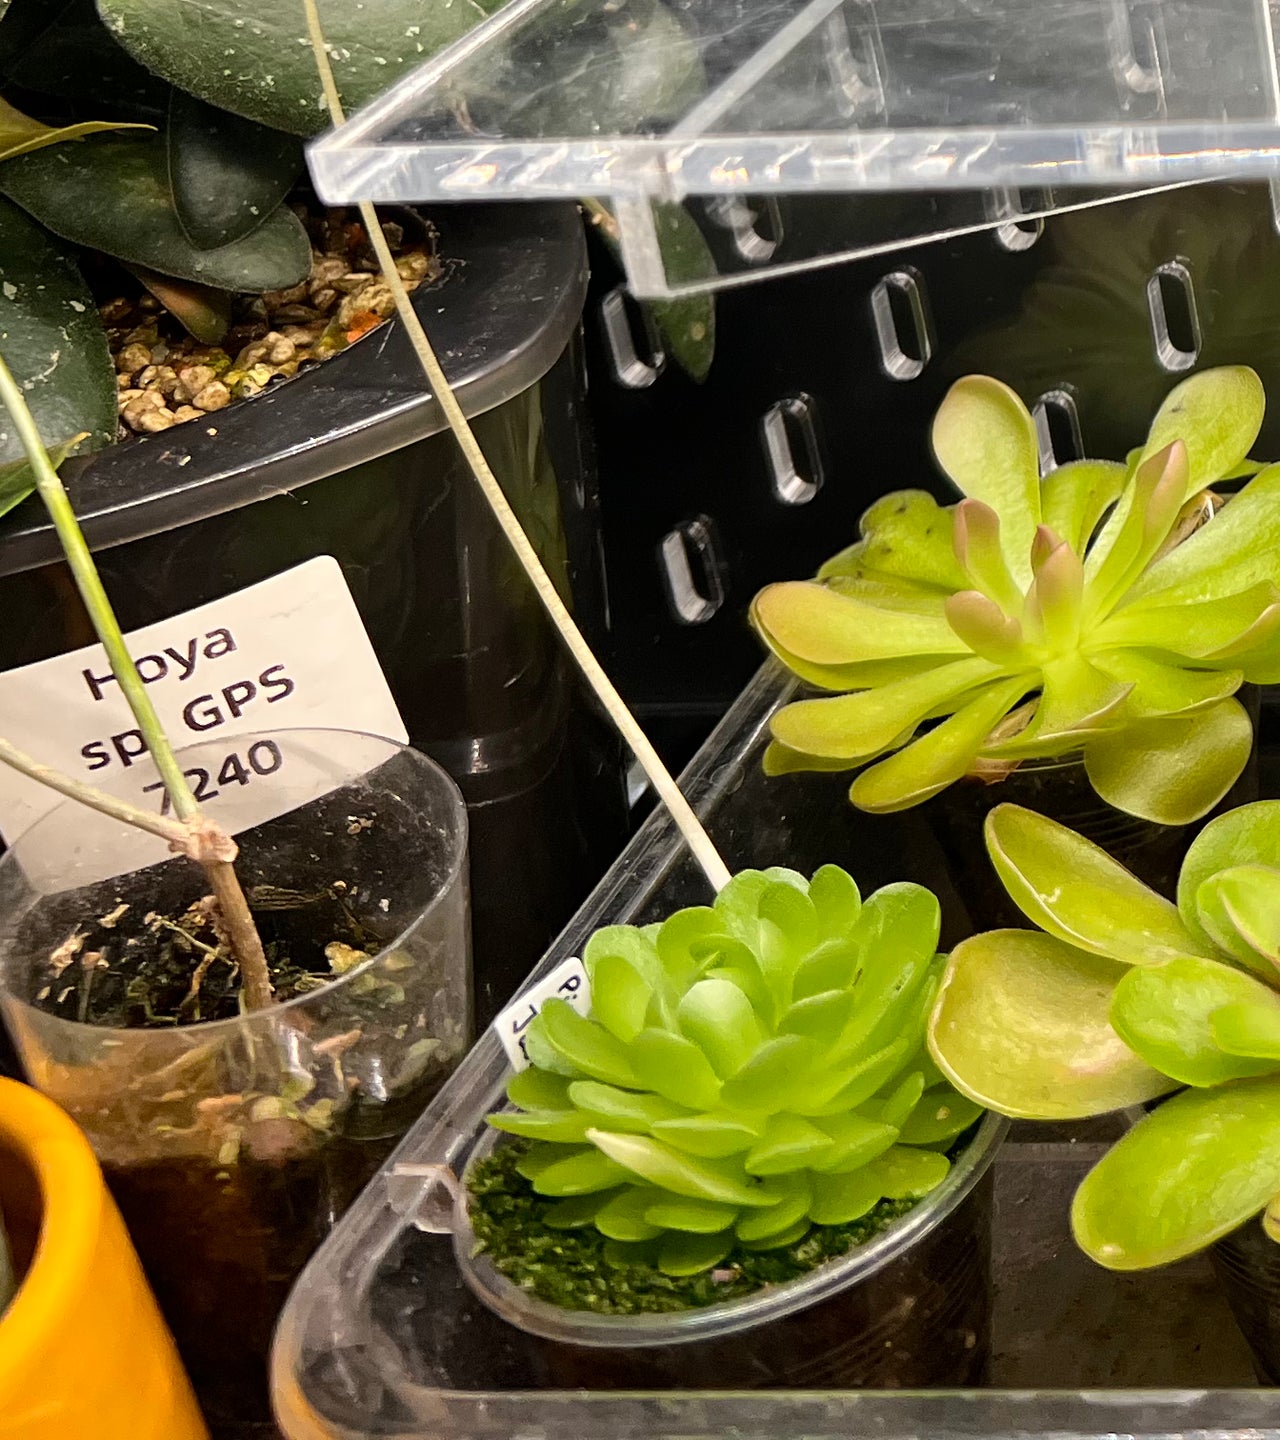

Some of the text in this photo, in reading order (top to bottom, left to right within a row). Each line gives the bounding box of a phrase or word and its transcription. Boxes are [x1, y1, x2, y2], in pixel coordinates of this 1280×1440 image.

[81, 627, 238, 701] Hoya
[182, 664, 295, 731] GPS
[142, 739, 283, 816] 7240
